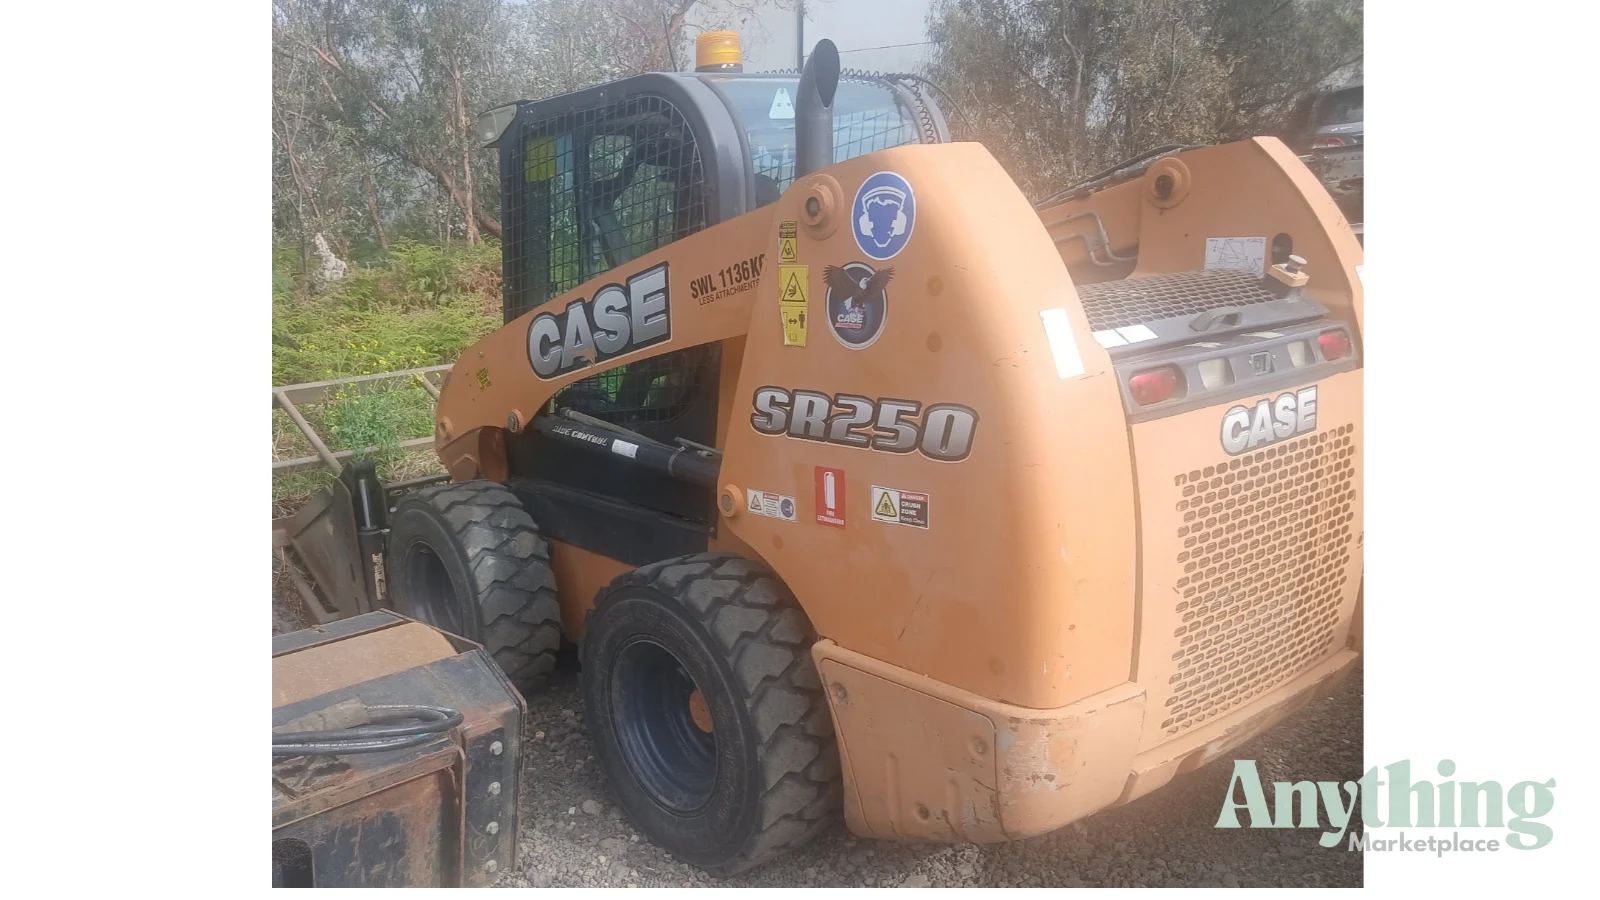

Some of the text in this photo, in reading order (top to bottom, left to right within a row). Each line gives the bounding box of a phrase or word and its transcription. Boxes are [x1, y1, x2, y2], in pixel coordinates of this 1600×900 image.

[690, 274, 717, 299] SWL
[699, 294, 715, 306] LESS
[527, 262, 671, 379] CASE
[837, 312, 864, 324] CASE
[751, 385, 979, 463] SR250
[1220, 385, 1318, 456] CASE
[900, 508, 917, 516] ZONE
[901, 501, 921, 509] CRUSH
